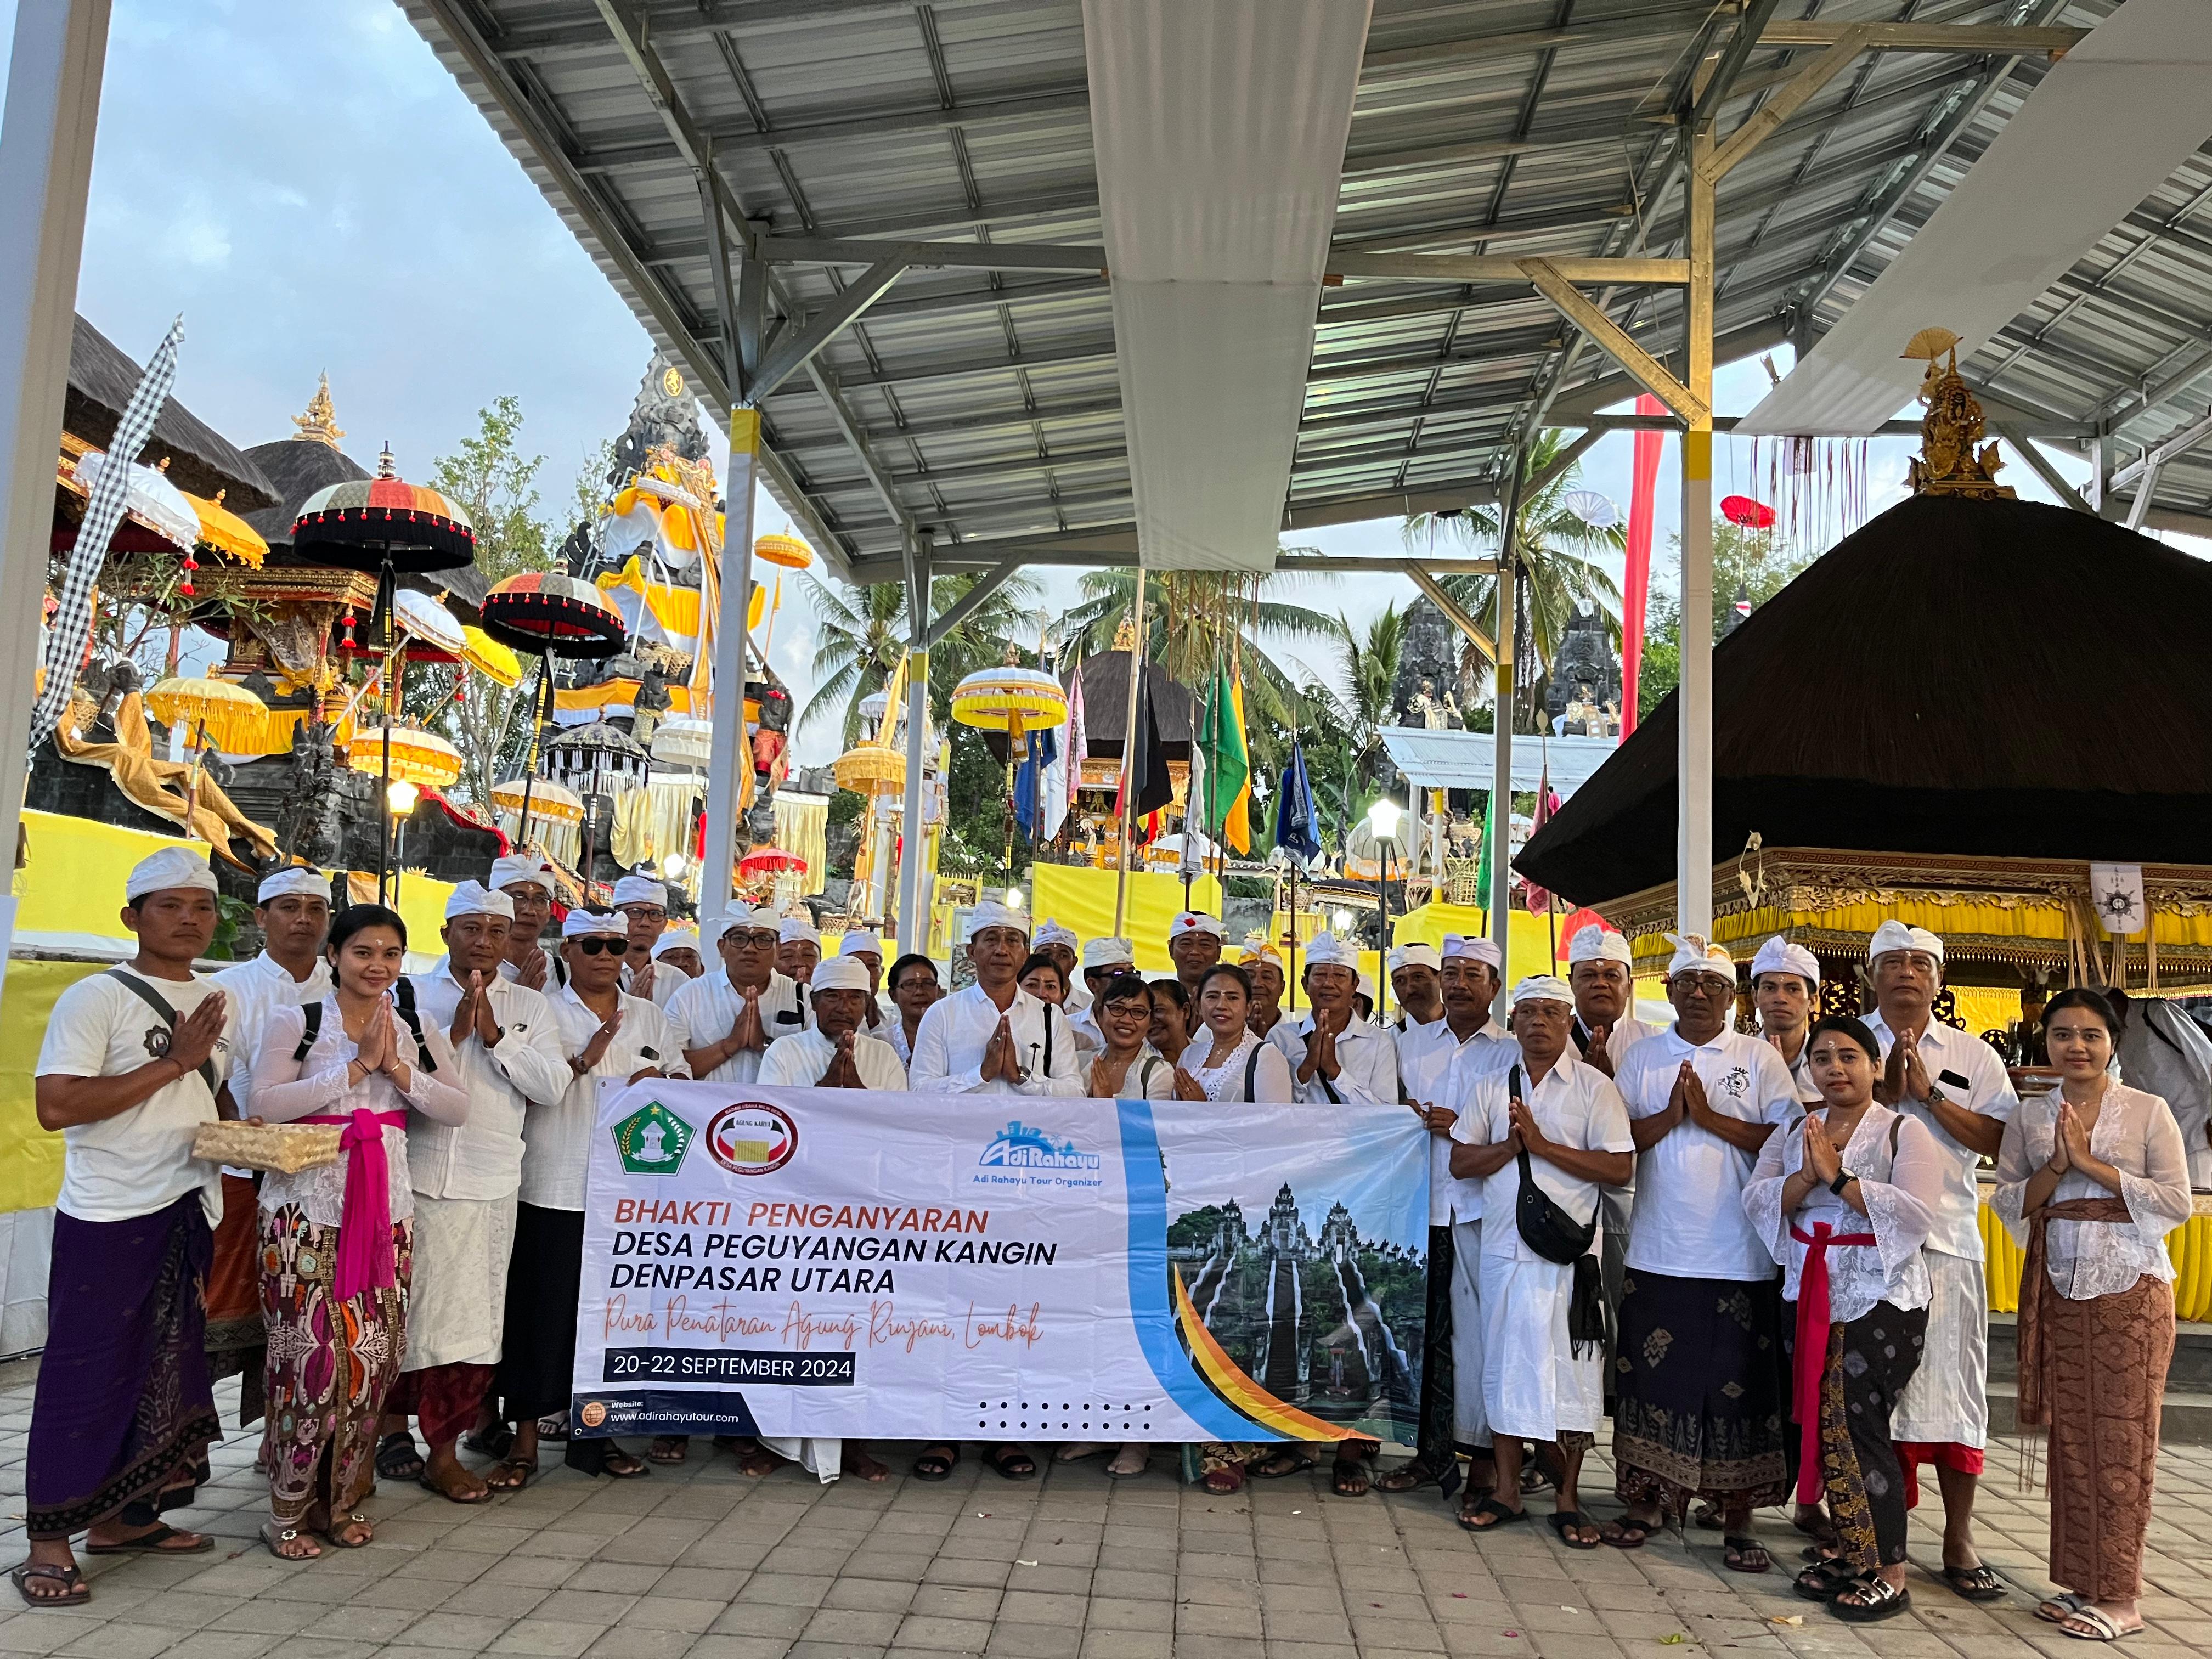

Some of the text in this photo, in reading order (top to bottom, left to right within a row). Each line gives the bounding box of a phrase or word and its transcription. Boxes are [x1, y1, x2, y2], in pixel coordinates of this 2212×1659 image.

[973, 1175, 1102, 1188] Adi Rahayu Tour Organizer
[614, 1199, 989, 1233] BHAKTI PENGANYARAN
[612, 1232, 1057, 1266] DESA PEGUYANGAN KANGIN
[610, 1264, 894, 1294] DENPASAR UTARA
[605, 1294, 1044, 1353] Pura Penataran Agung Rinjani, Lombok
[613, 1356, 851, 1378] 20-22 SEPTEMBER 2024
[611, 1412, 738, 1423] www.adirahayutour.com
